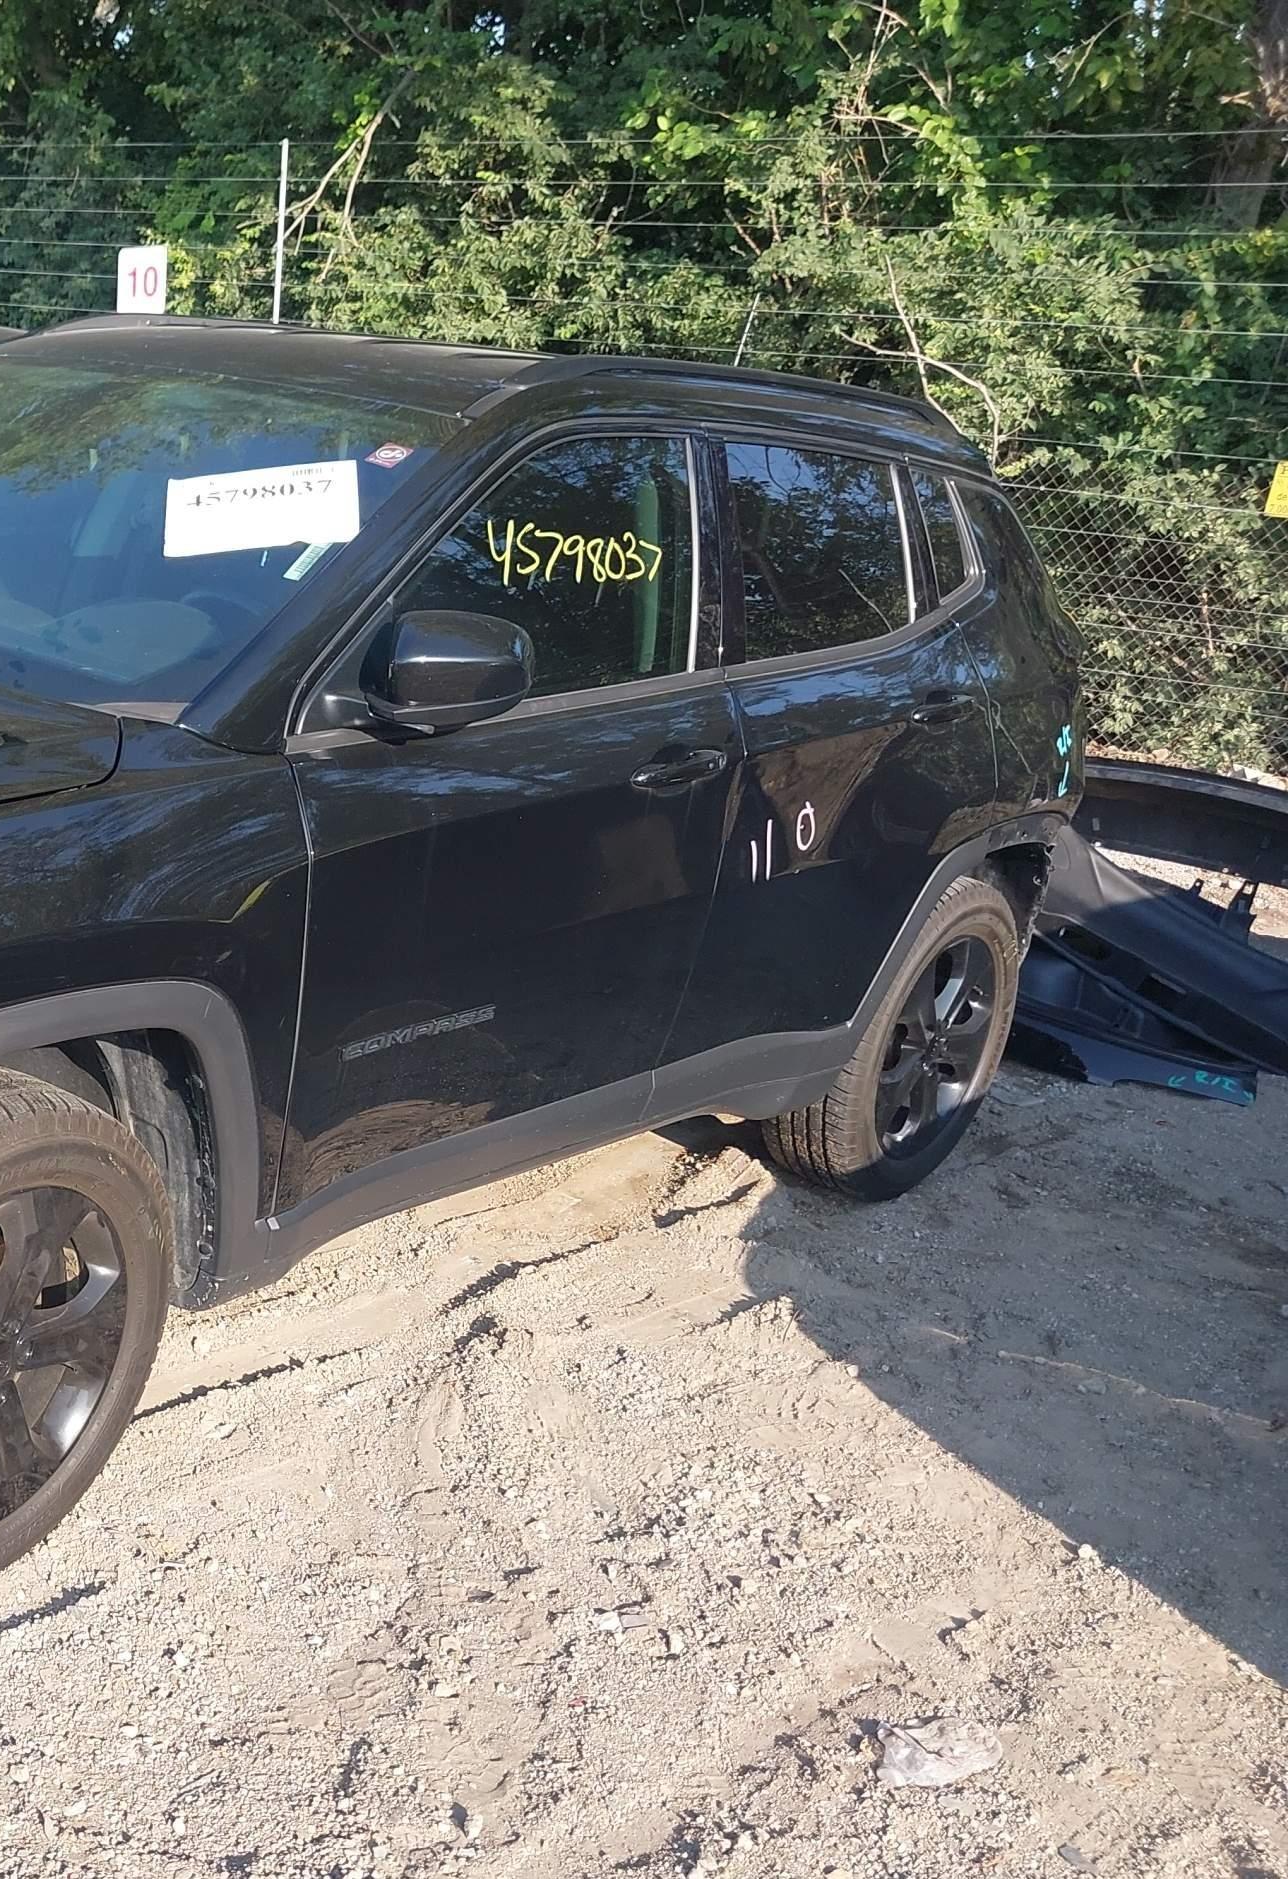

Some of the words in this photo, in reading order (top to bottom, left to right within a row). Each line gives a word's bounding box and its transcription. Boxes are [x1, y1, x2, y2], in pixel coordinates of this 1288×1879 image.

[127, 265, 158, 297] 10
[487, 518, 663, 587] 45798037
[339, 1003, 497, 1063] COMPASS
